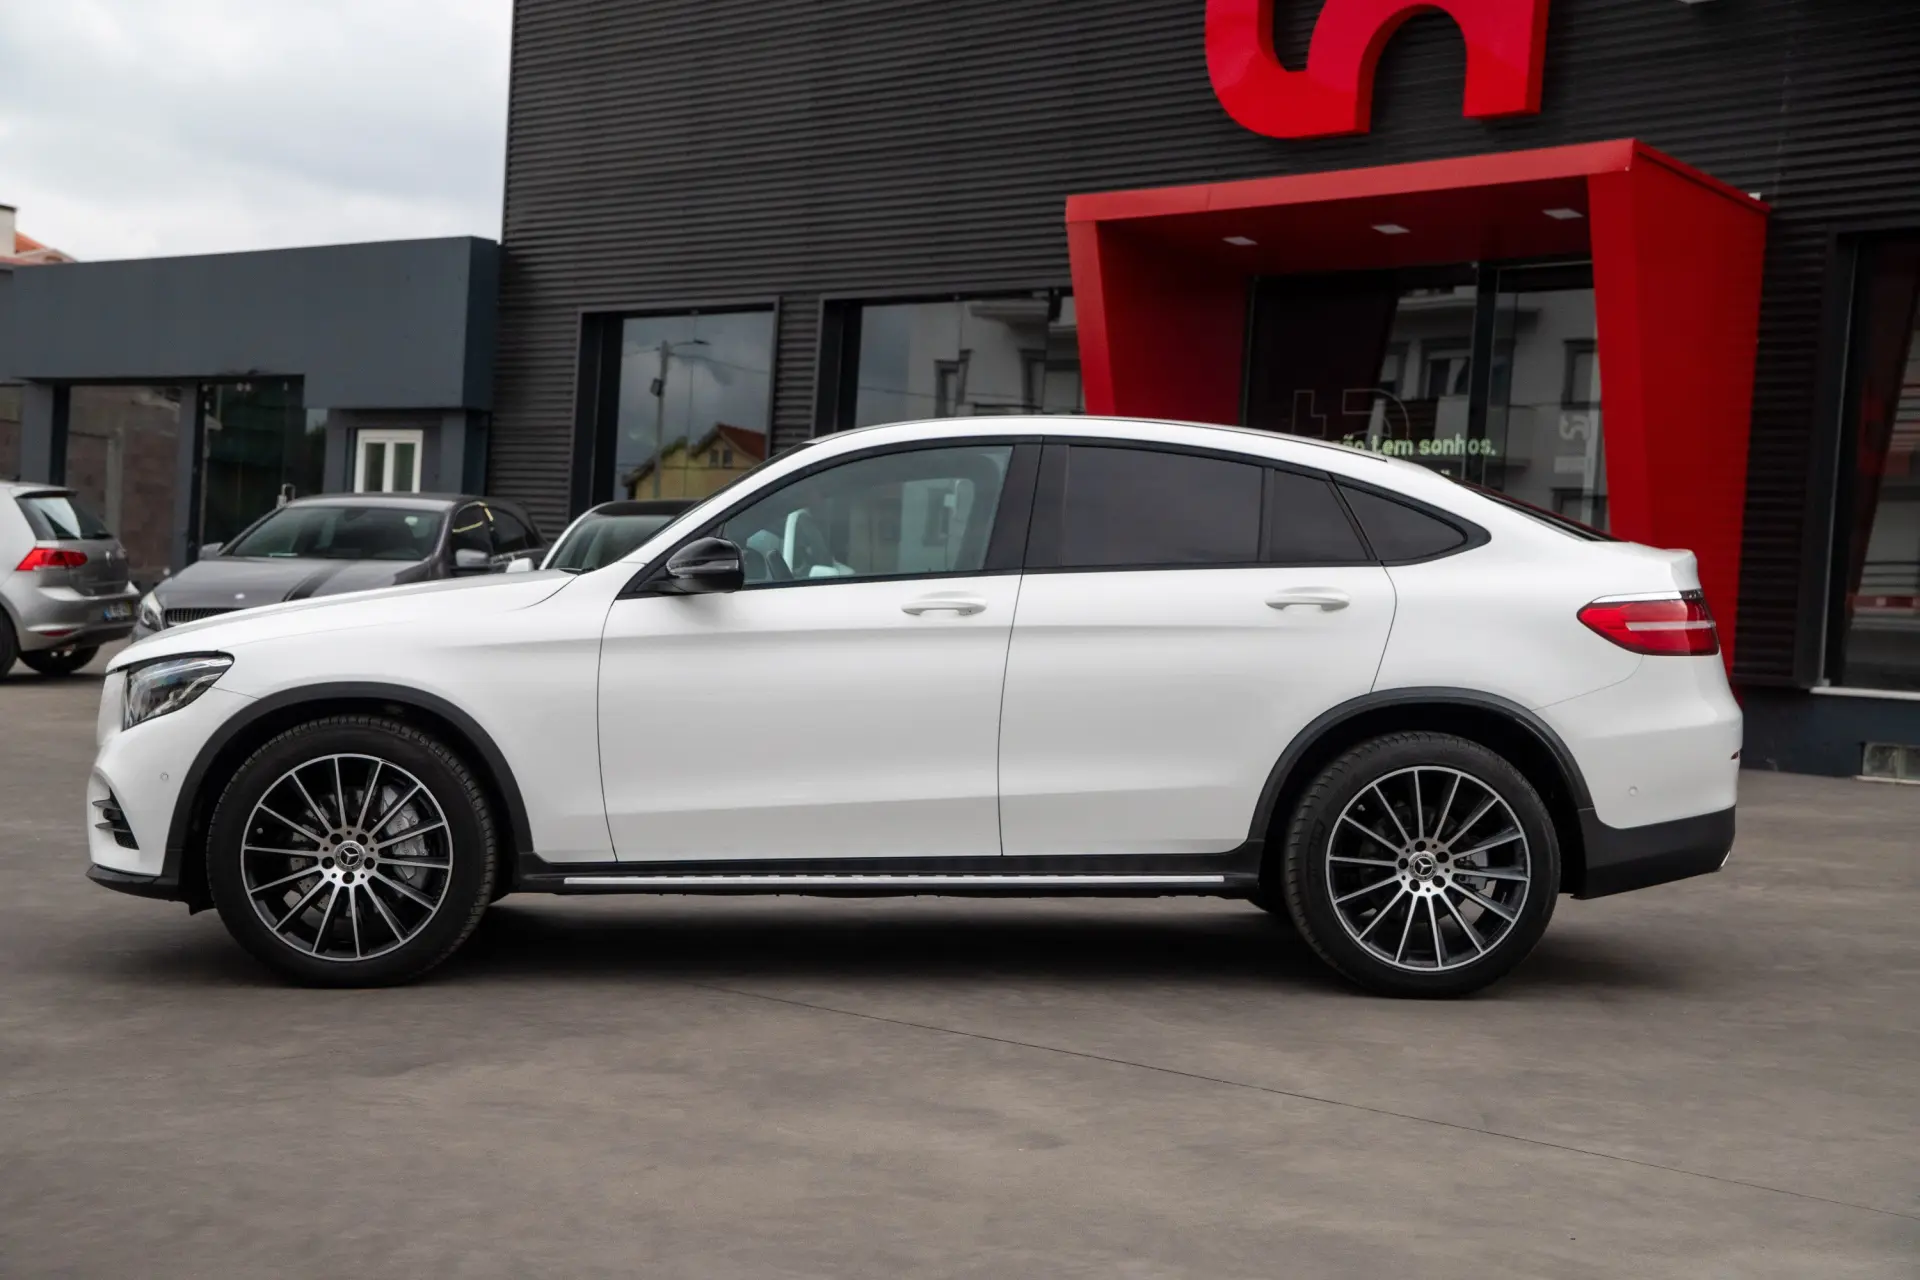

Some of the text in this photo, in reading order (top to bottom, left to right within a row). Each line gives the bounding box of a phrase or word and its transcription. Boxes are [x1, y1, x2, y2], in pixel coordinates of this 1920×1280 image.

[1332, 433, 1497, 456] ão tem sonhos.
